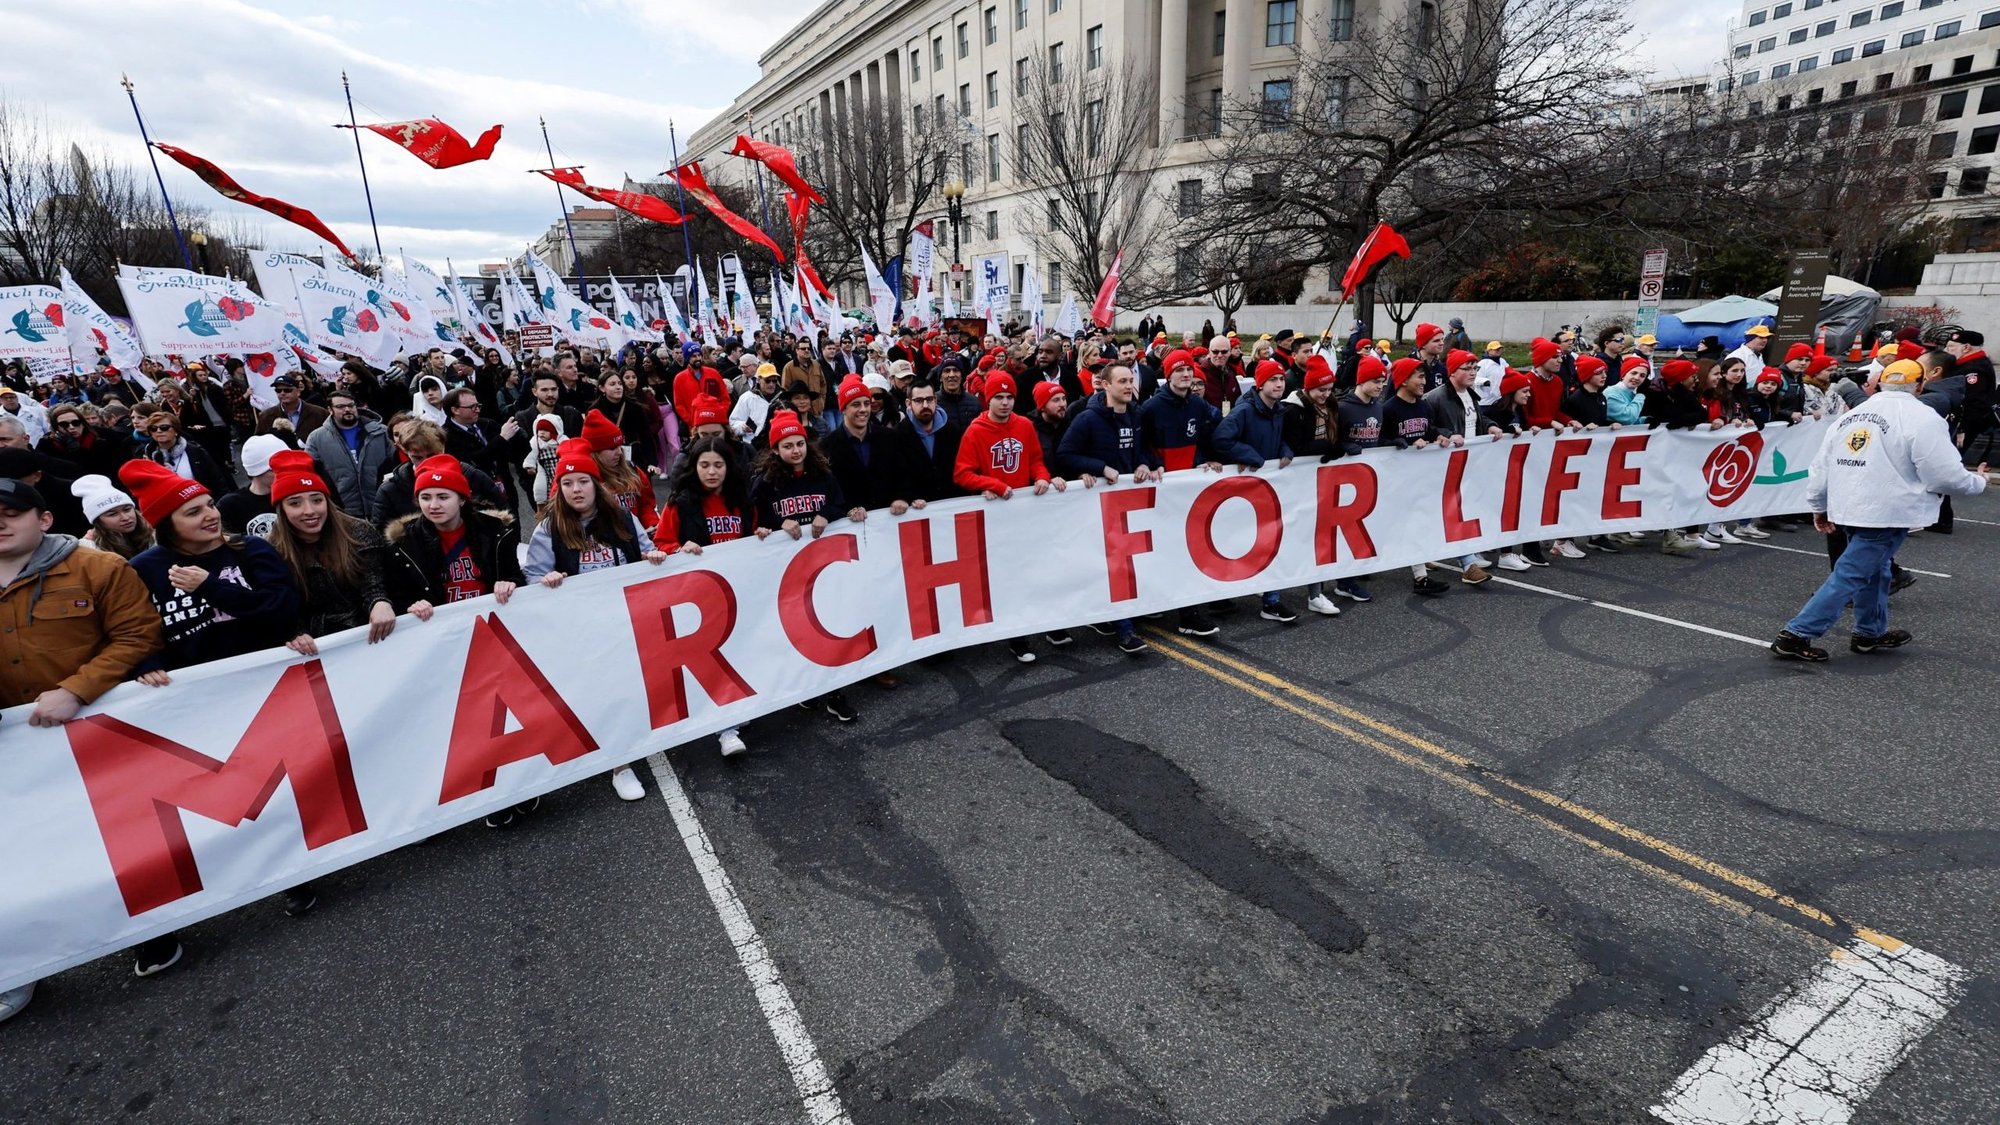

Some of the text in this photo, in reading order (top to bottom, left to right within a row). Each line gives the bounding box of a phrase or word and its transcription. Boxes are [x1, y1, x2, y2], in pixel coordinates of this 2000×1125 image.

[39, 287, 64, 299] for
[161, 341, 197, 351] Support
[1858, 412, 1868, 422] OF
[991, 437, 1023, 473] LU
[1836, 458, 1866, 468] VIRGINIA
[706, 515, 742, 536] BERT
[66, 435, 1652, 917] MARCH FOR LIFE
